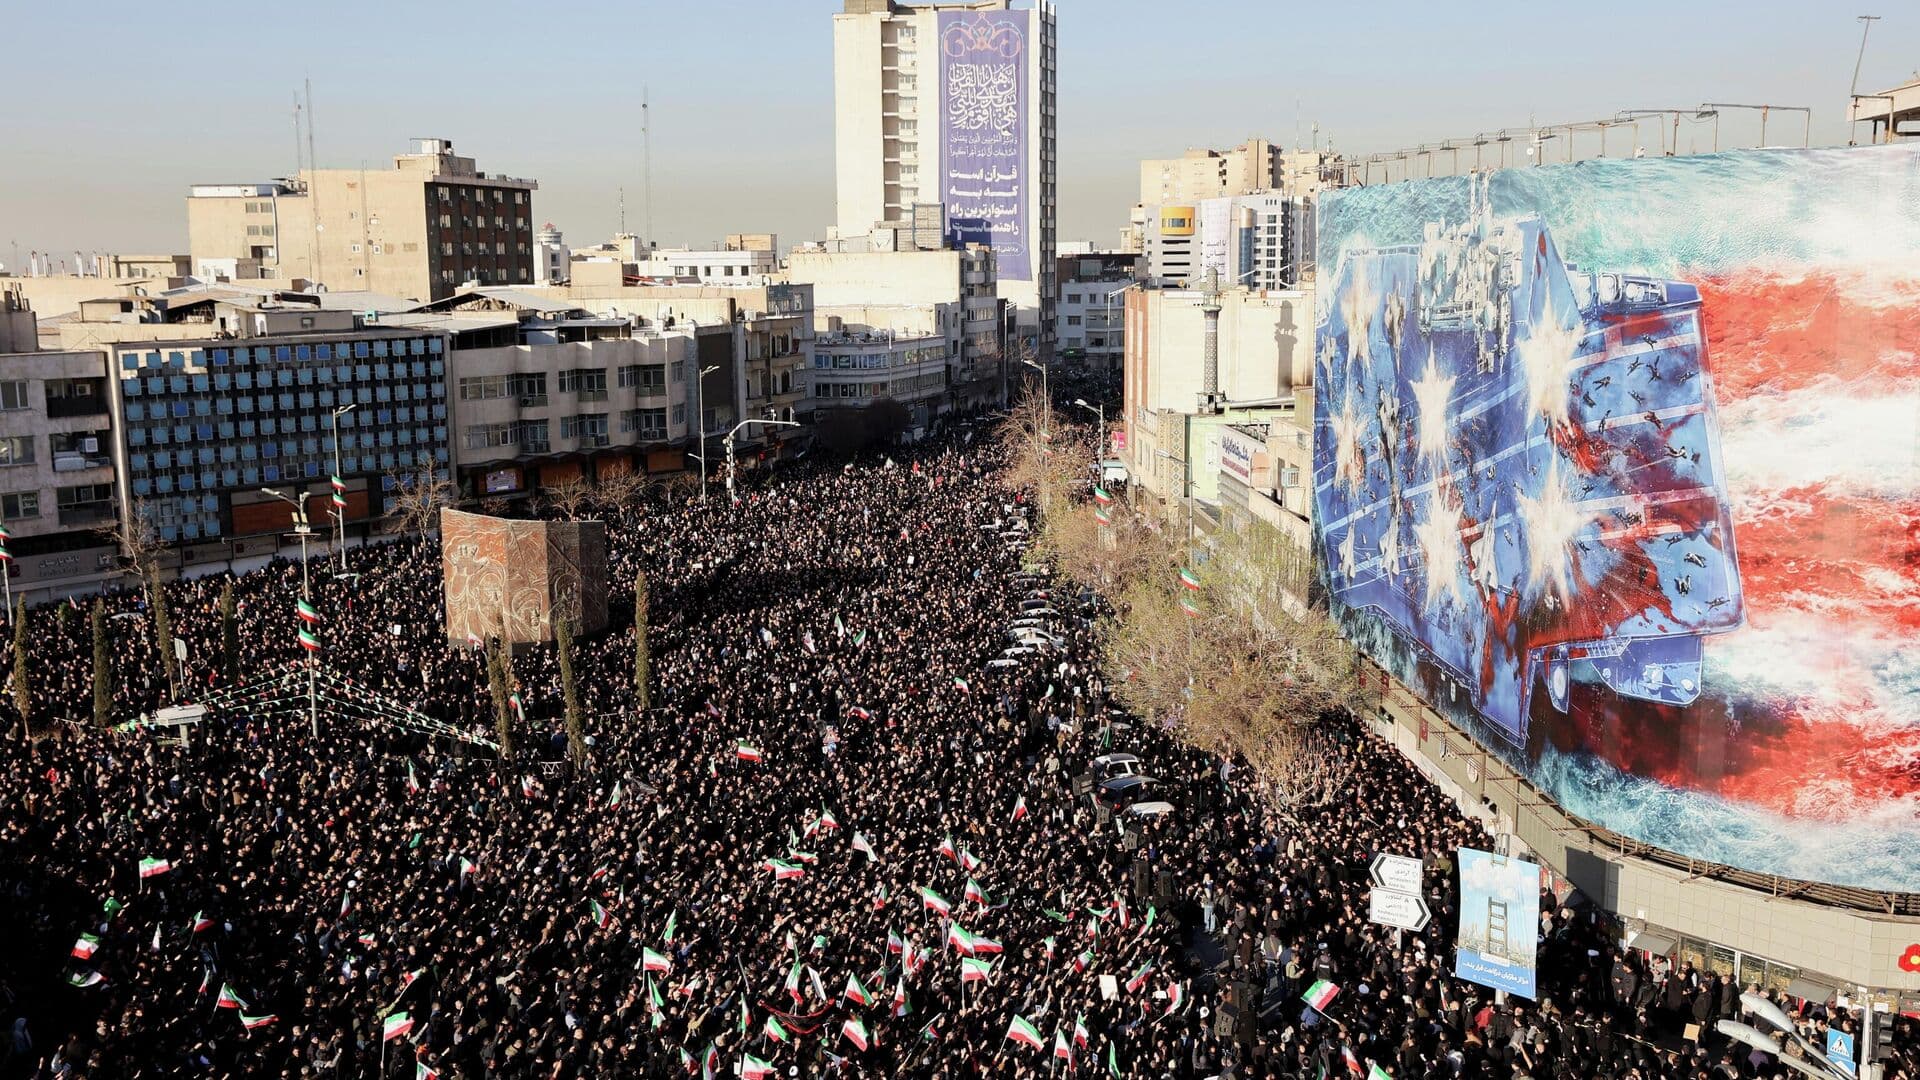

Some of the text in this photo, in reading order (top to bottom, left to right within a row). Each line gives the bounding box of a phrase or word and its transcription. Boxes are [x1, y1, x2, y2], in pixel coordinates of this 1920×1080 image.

[949, 164, 1018, 182] قرآن است
[949, 185, 1019, 199] که به
[950, 202, 1018, 218] استوارترین راه
